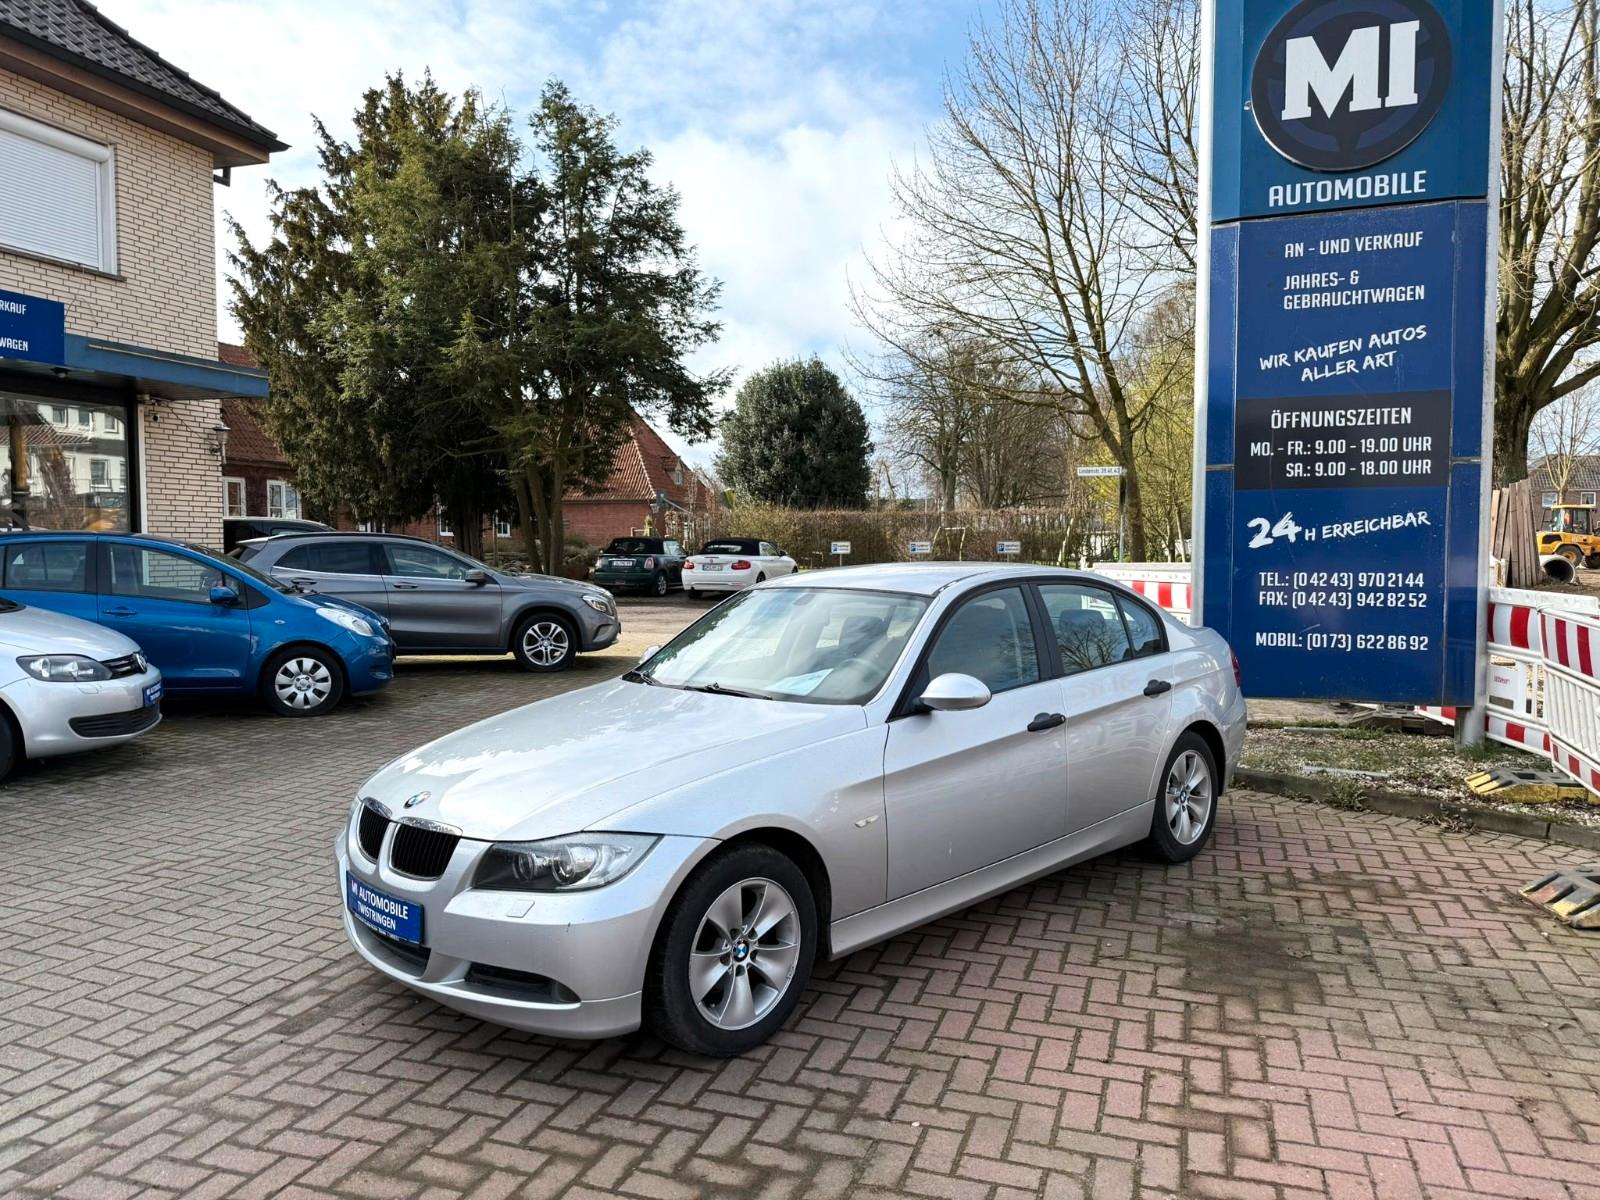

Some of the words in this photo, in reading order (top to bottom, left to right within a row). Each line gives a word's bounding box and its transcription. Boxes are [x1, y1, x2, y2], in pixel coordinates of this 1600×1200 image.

[1282, 20, 1420, 120] MI
[1269, 170, 1427, 208] AUTOMOBILE
[1284, 242, 1304, 259] AN
[1319, 238, 1350, 255] UND
[1355, 231, 1424, 252] VERKAUF
[1283, 271, 1345, 290] JAHRES-
[1350, 270, 1359, 285] &
[1283, 285, 1425, 310] GEBRAUCHTWAGEN
[1259, 353, 1291, 370] WIR
[1294, 338, 1362, 363] KAUFEN
[1368, 325, 1427, 349] AUTOS
[1301, 359, 1359, 382] ALLER
[1362, 350, 1398, 370] ART
[1270, 407, 1412, 429] ÖFFNUNGSZEITEN
[1250, 442, 1274, 457] MO.
[1287, 441, 1311, 456] FR.:
[1315, 439, 1346, 455] 9.00
[1360, 437, 1398, 453] 19.00
[1402, 436, 1432, 452] UHR
[1286, 462, 1311, 477] SA.:
[1315, 461, 1346, 476] 9.00
[1360, 460, 1398, 476] 18.00
[1402, 459, 1432, 475] UHR
[1247, 511, 1302, 549] 24
[1322, 511, 1431, 539] ERREICHBAR
[1259, 572, 1289, 587] TEL.:
[1259, 591, 1288, 606] FAX:
[1255, 632, 1302, 647] MOBIL:
[357, 901, 396, 931] TWISTRINGEN
[359, 886, 409, 920] AUTOMOBILE
